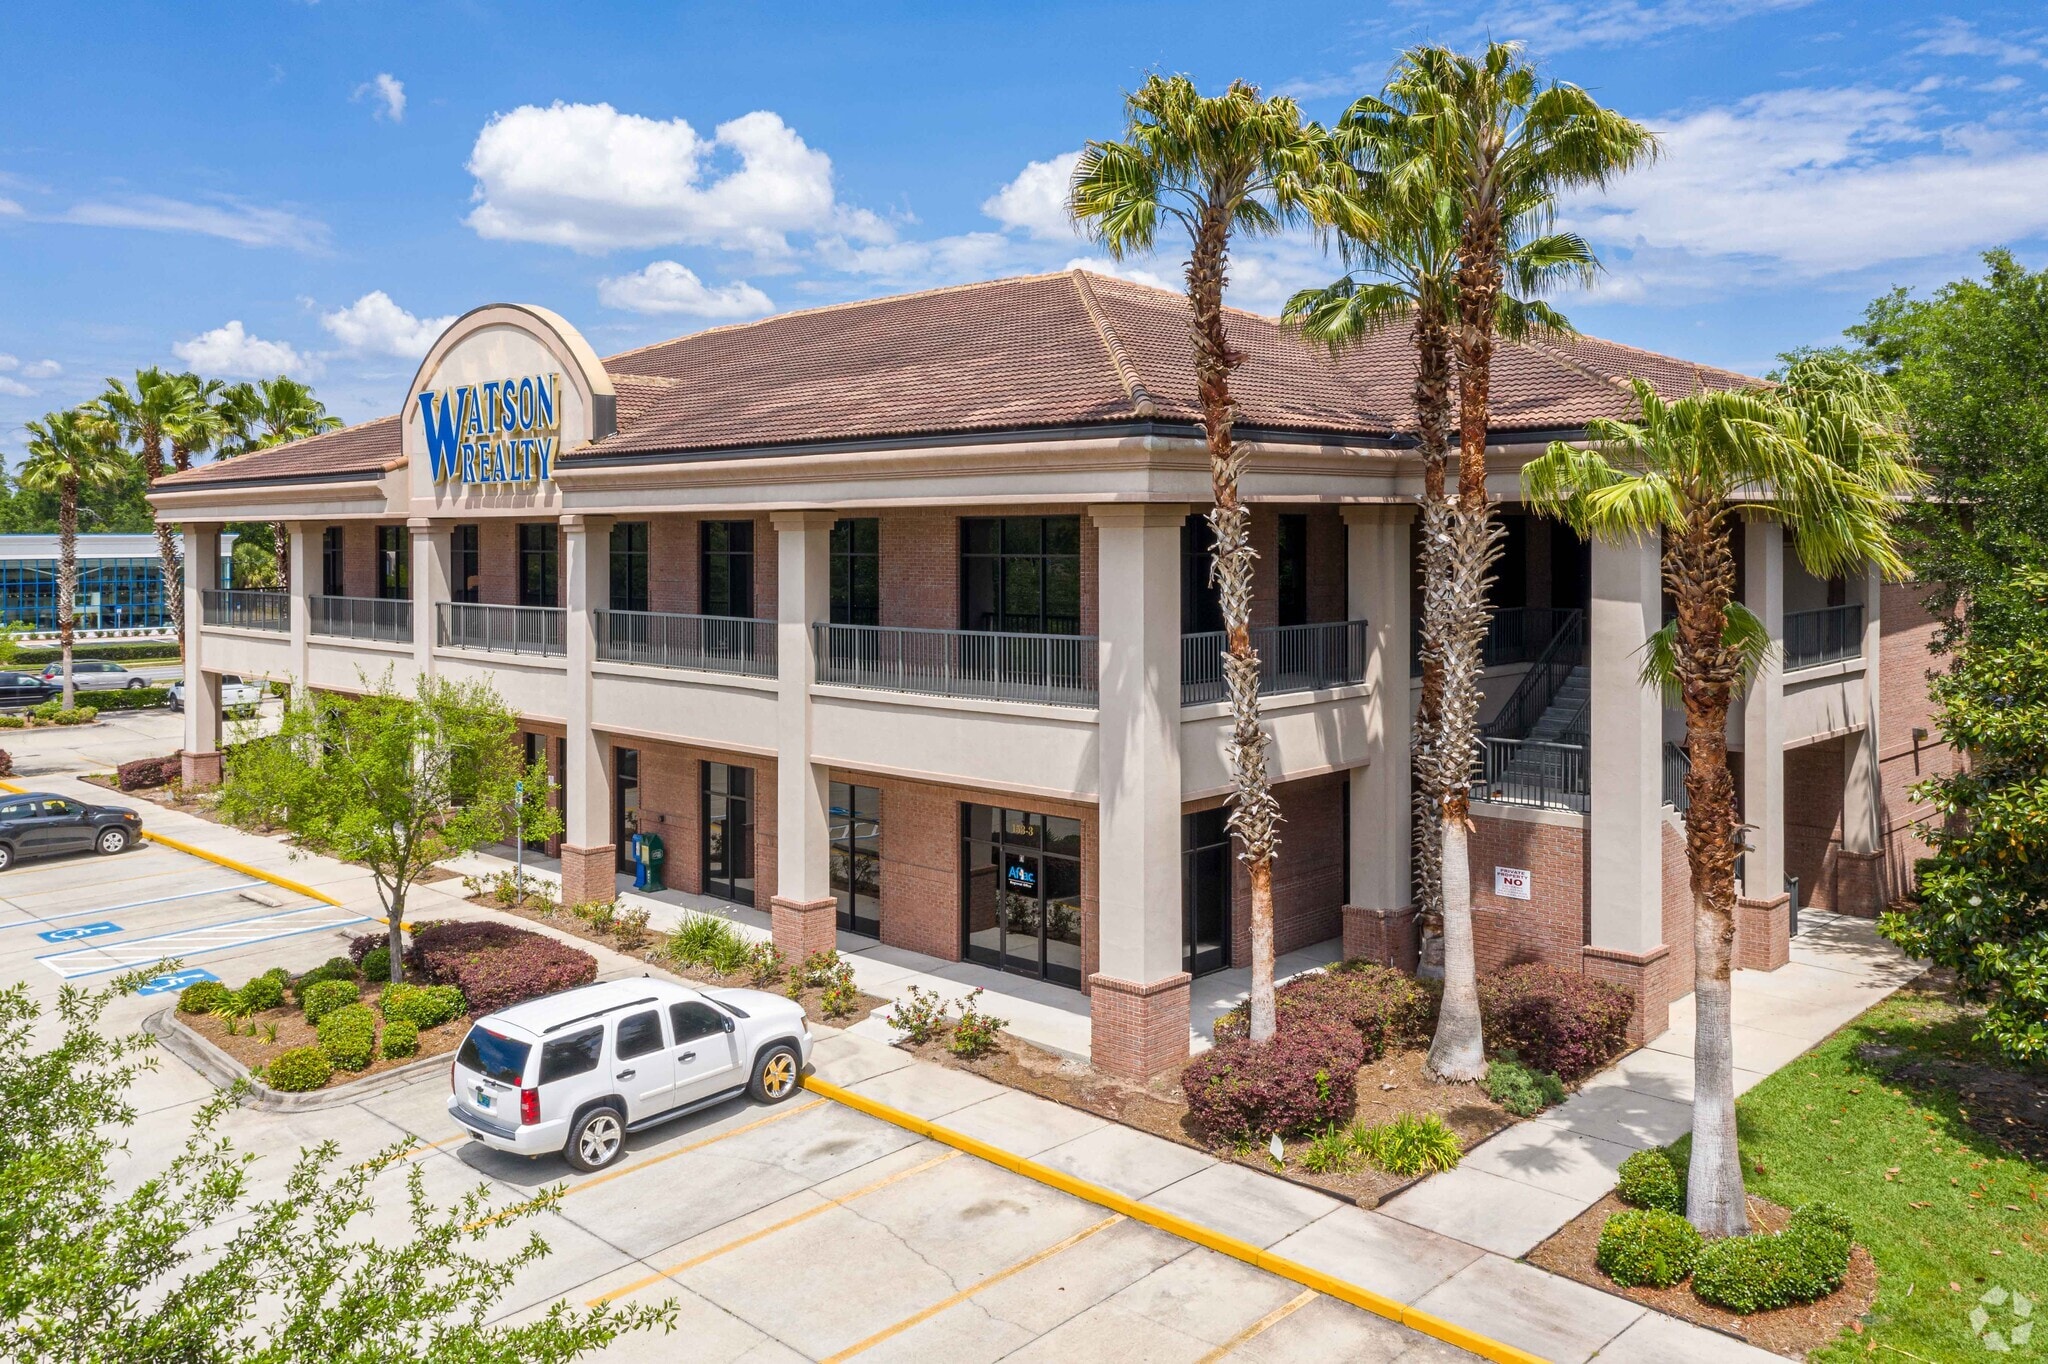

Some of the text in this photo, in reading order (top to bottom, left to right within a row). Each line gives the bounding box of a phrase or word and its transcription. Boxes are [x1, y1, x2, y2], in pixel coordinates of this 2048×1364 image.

[418, 372, 556, 482] WATSON
[461, 437, 554, 484] REALTY
[1504, 877, 1523, 886] NO
